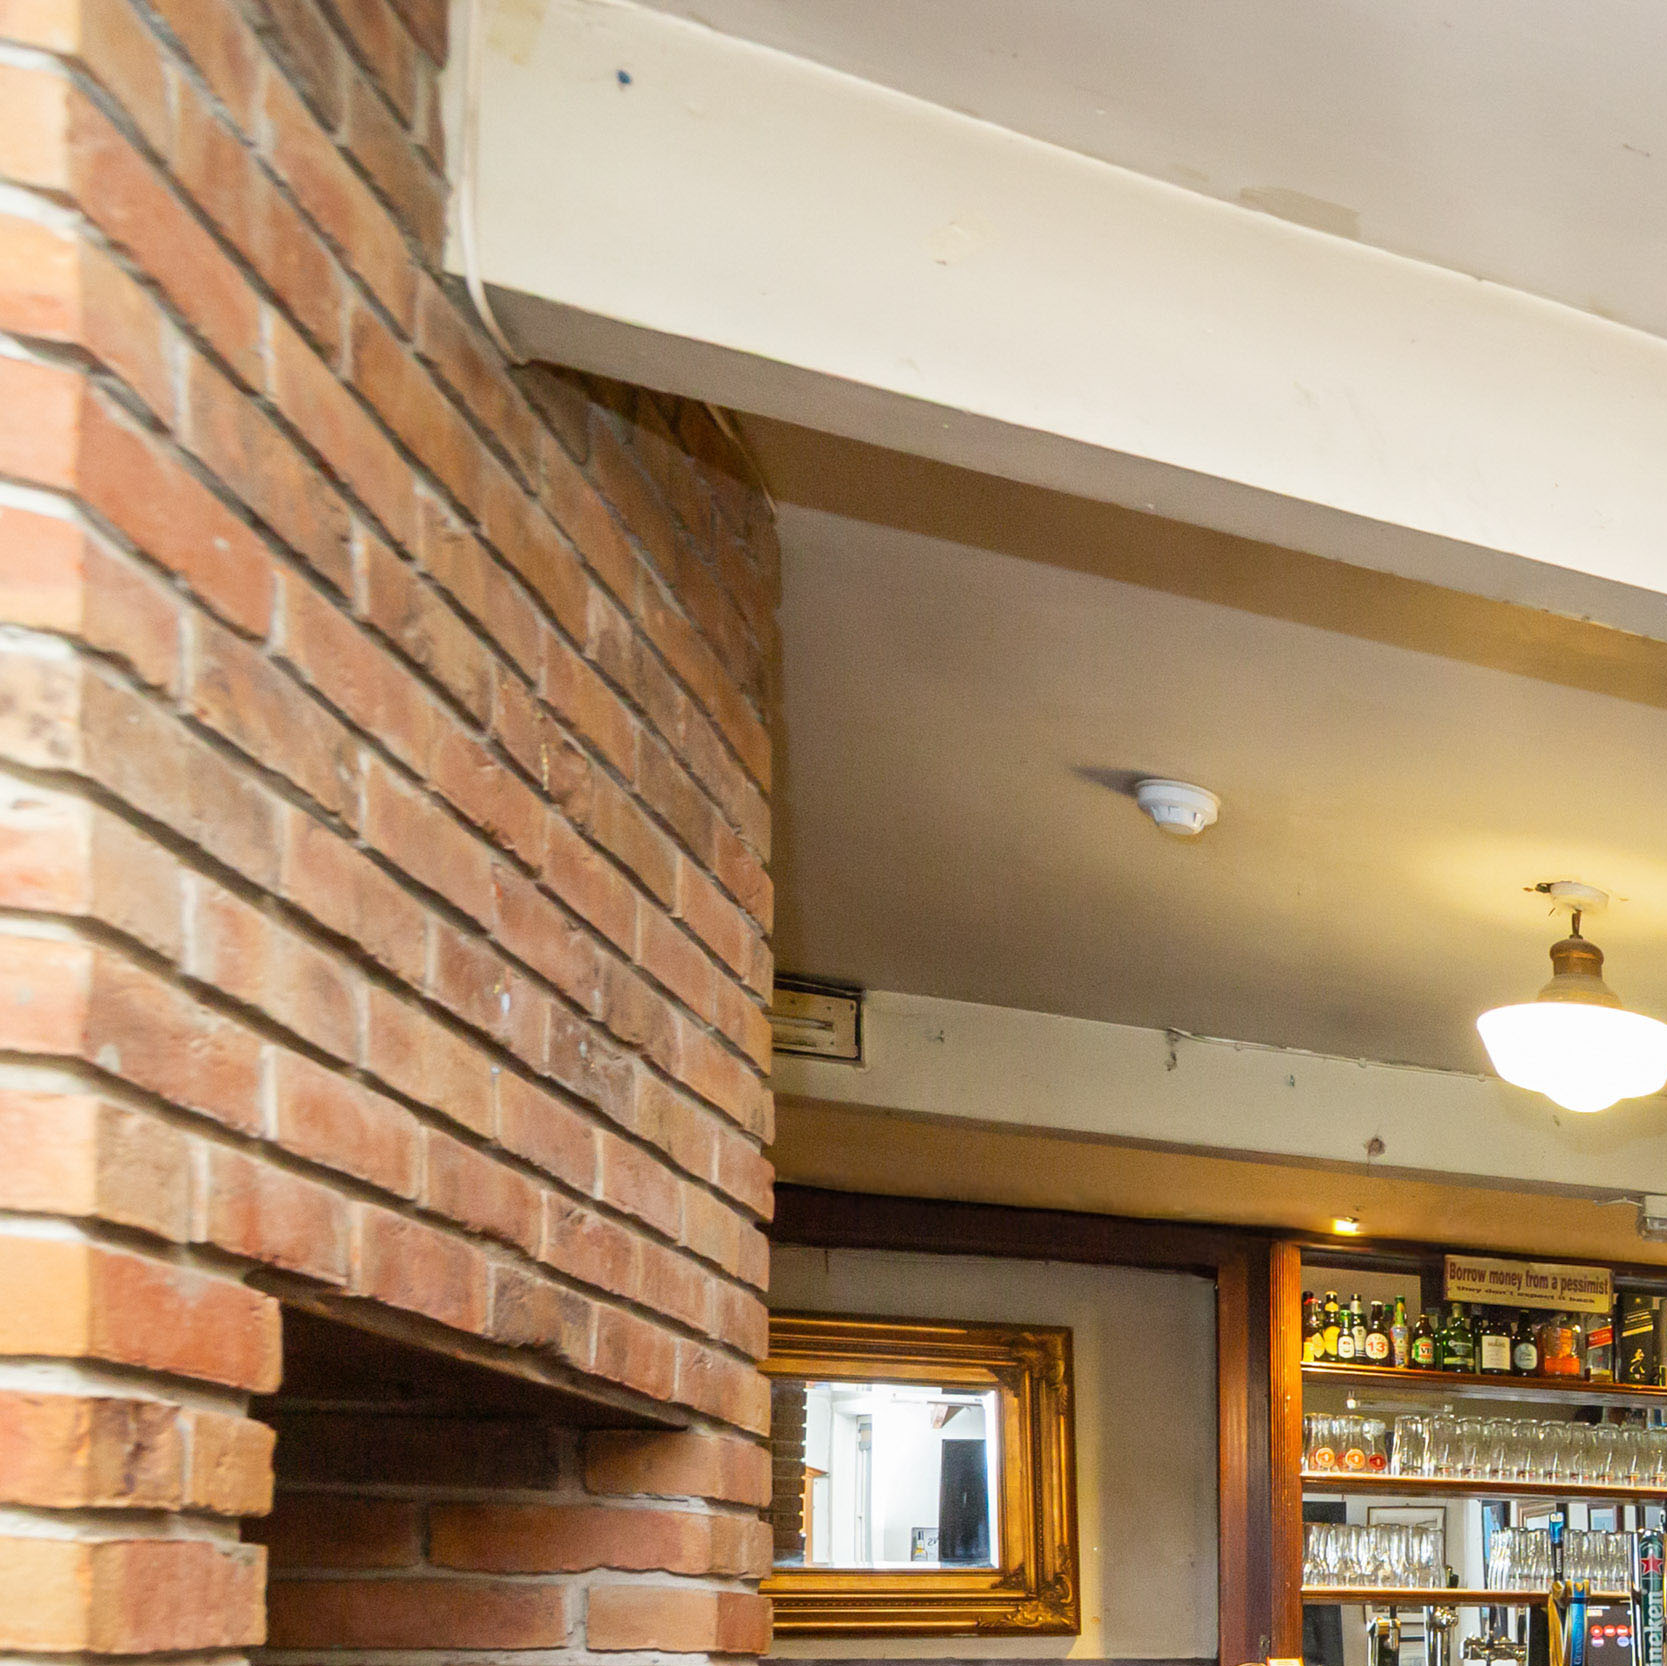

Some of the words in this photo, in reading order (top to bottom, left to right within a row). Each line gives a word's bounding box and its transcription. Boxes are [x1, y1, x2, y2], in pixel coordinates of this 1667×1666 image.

[1449, 1262, 1486, 1283] Borrow
[1489, 1271, 1523, 1290] money
[1525, 1270, 1549, 1289] from
[1551, 1278, 1557, 1289] a
[1560, 1276, 1608, 1295] pessimist
[1368, 1341, 1385, 1353] 13
